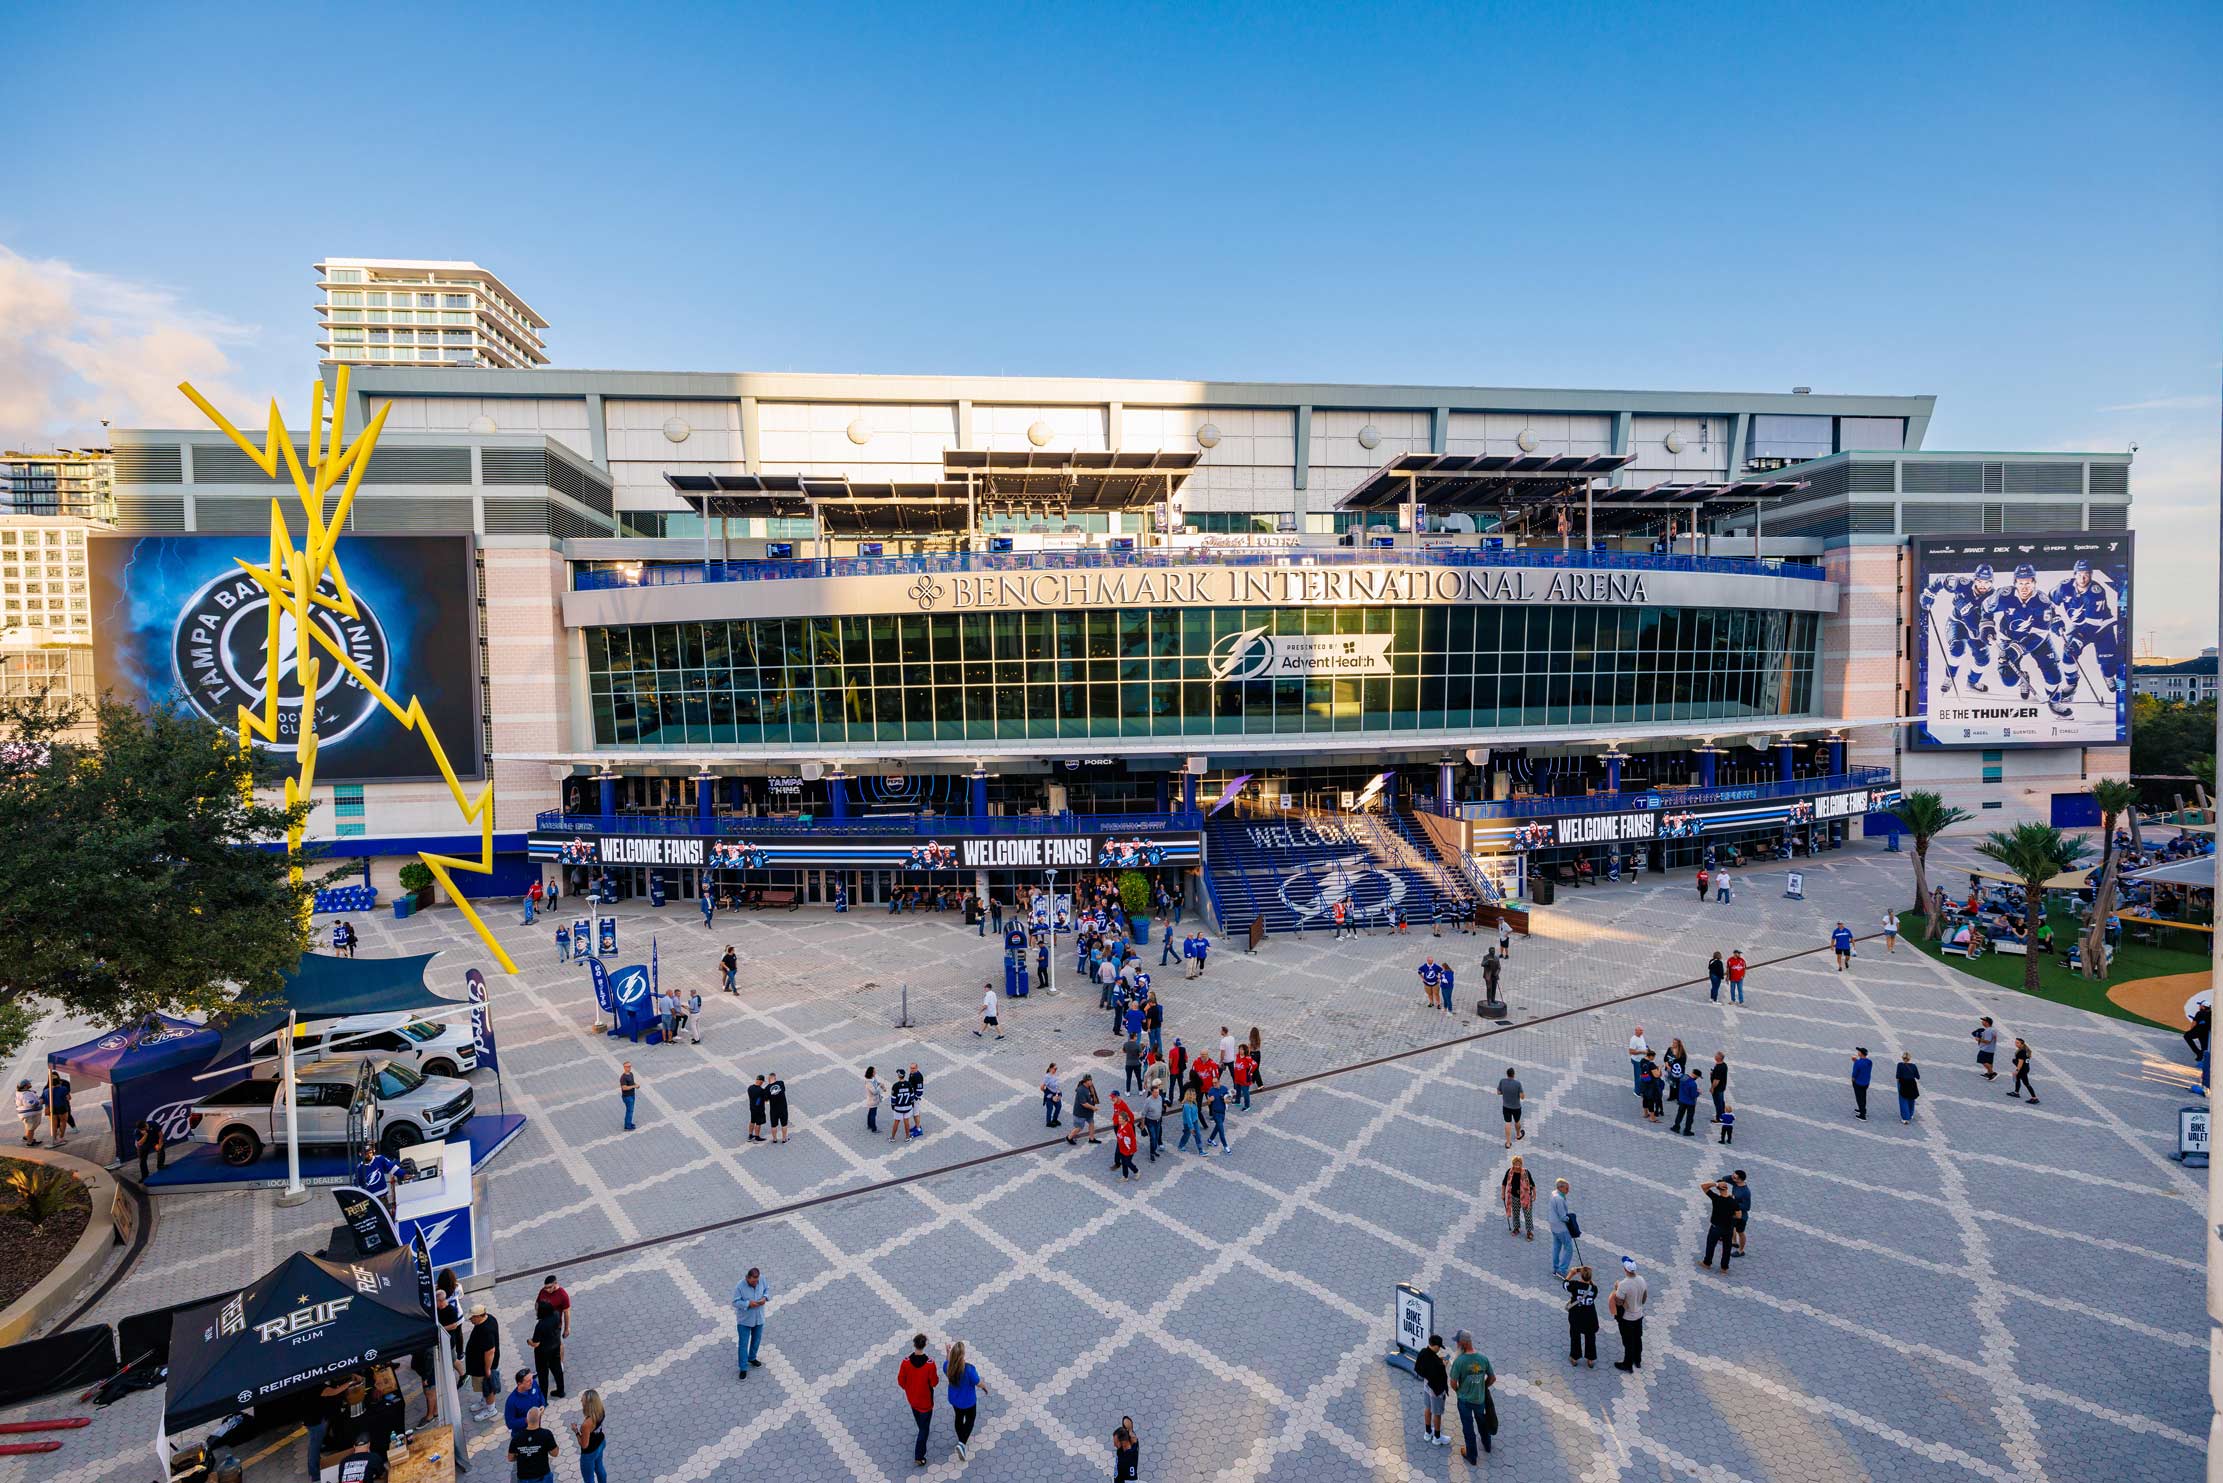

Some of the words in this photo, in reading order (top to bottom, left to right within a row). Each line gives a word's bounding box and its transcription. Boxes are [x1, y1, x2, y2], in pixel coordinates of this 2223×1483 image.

[1258, 537, 1300, 547] ULTRA
[952, 571, 1213, 608] BENCHMARK
[1228, 568, 1534, 602] INTERNATIONAL
[1545, 572, 1649, 602] ARENA
[190, 613, 231, 704] TAMPA
[214, 578, 265, 610] BAY
[1282, 656, 1374, 669] AdventHealth
[1940, 710, 1950, 719] BE
[1953, 709, 1969, 719] THE
[1972, 708, 2038, 719] THUNDER
[768, 778, 804, 786] TAMPA
[1815, 793, 1849, 819] WELCOME
[1850, 791, 1868, 814] FANS!
[1558, 816, 1619, 843] WELCOME
[1620, 813, 1655, 839] FANS!
[600, 838, 662, 864] WELCOME
[664, 839, 704, 864] FANS!
[964, 839, 1042, 866] WELCOME
[1045, 838, 1092, 865] FANS!
[467, 979, 491, 1058] Ford
[897, 1093, 910, 1105] 77
[2188, 1132, 2208, 1142] VALET
[2190, 1123, 2206, 1133] BIKE
[267, 1178, 290, 1187] LOCAL
[313, 1176, 344, 1185] DEALERS
[344, 1199, 370, 1217] REIF
[350, 1263, 379, 1295] REIF
[221, 1290, 247, 1337] REIF
[253, 1295, 354, 1344] REIF
[1405, 1308, 1421, 1326] BIKE
[292, 1330, 324, 1346] RUM
[1403, 1319, 1424, 1340] VALET
[259, 1356, 359, 1395] REIFRUM.COM
[1129, 1466, 1135, 1477] 9
